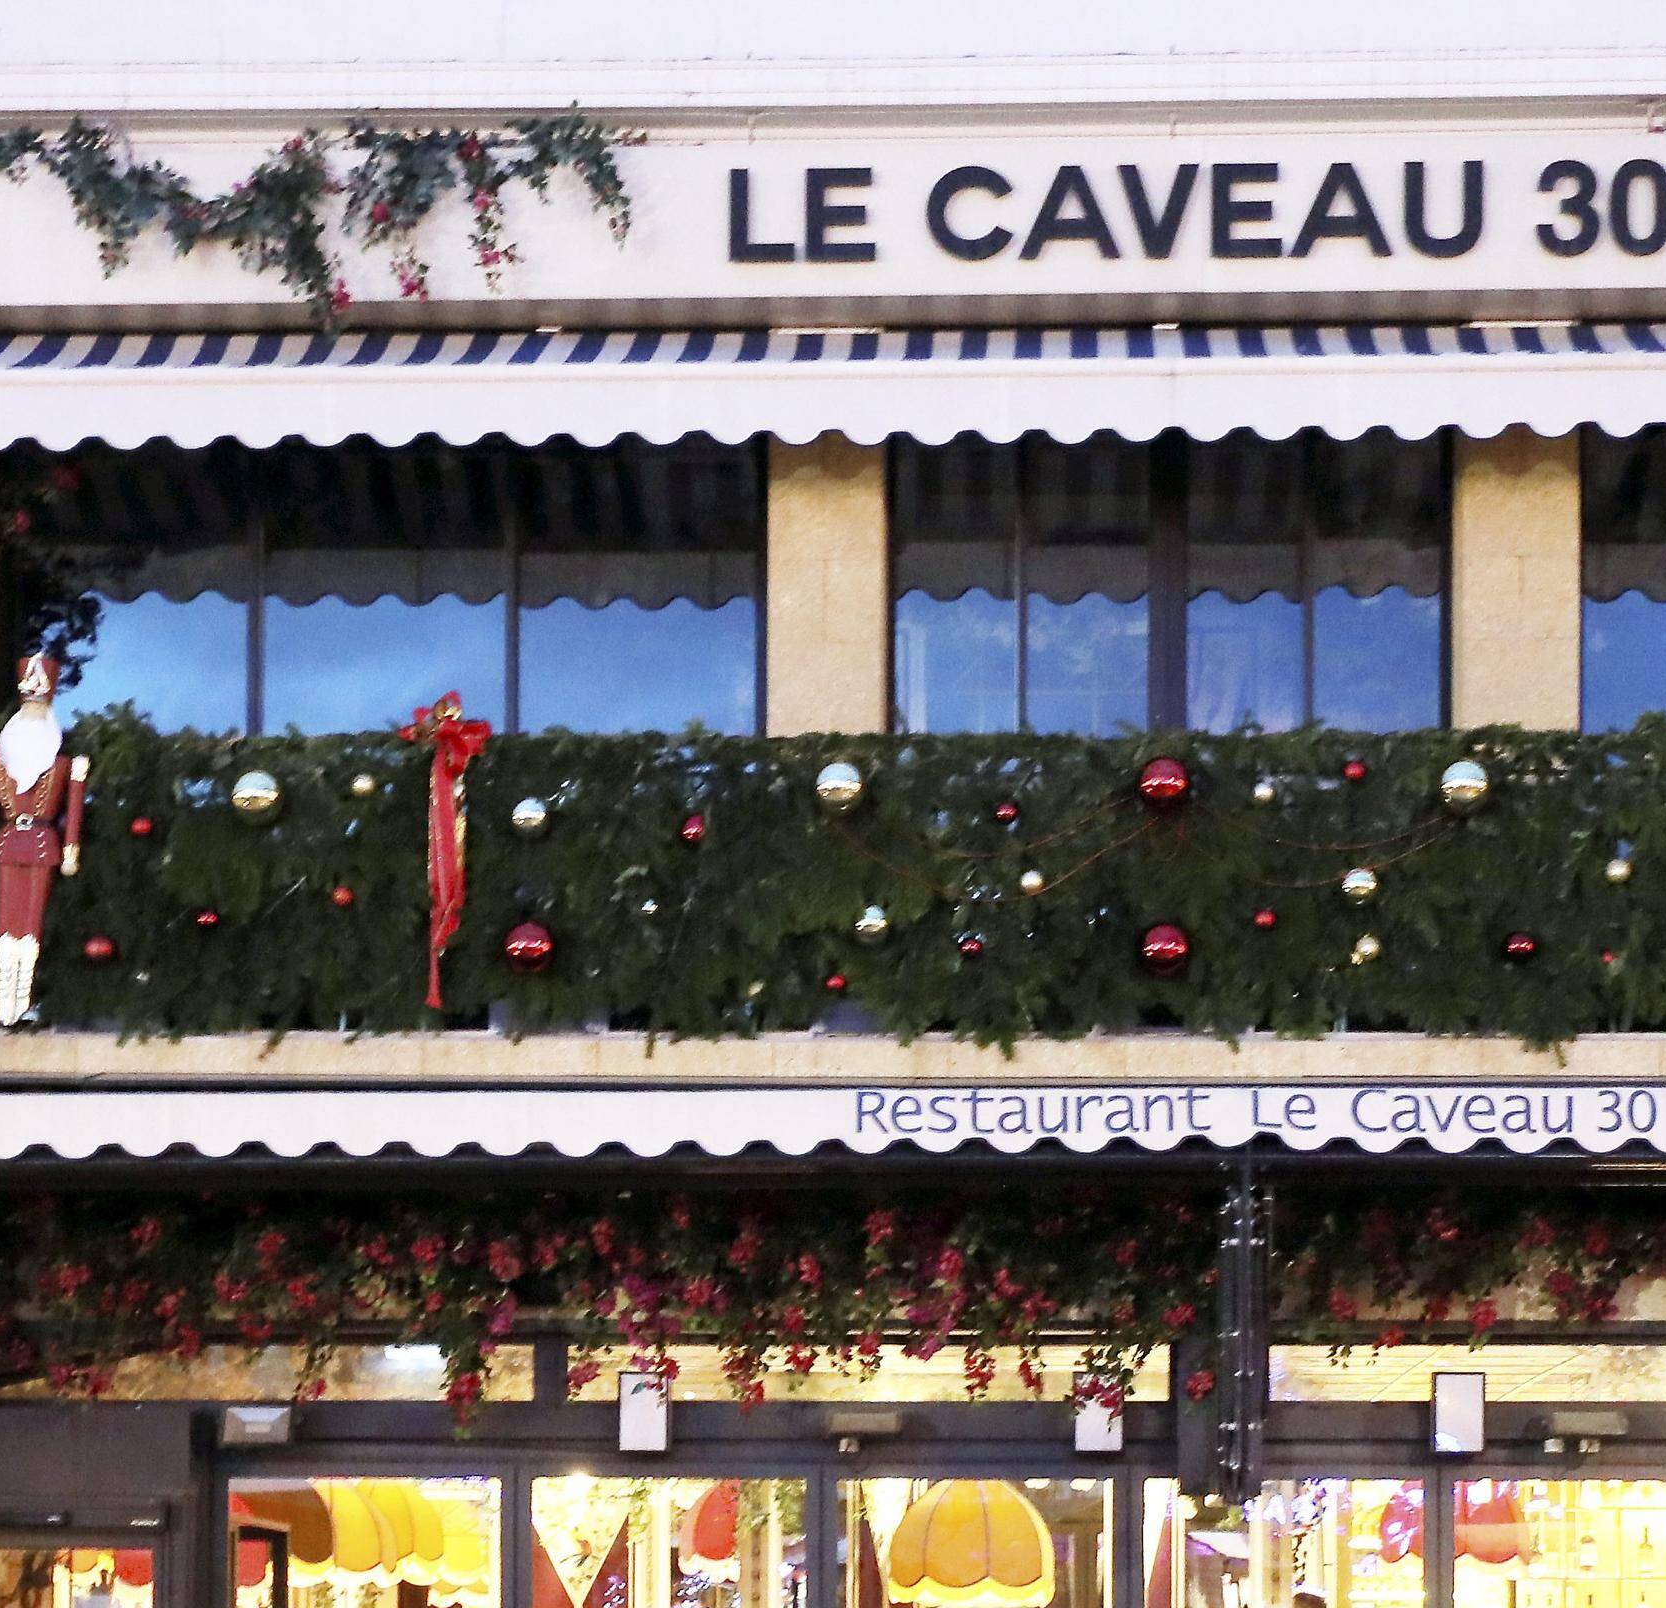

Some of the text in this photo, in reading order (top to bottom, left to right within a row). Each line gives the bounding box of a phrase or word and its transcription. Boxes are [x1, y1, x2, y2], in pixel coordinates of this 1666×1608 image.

[729, 166, 878, 264] LE
[926, 160, 1485, 262] CAVEAU
[854, 1087, 1659, 1135] Restaurant Le Caveau 30
